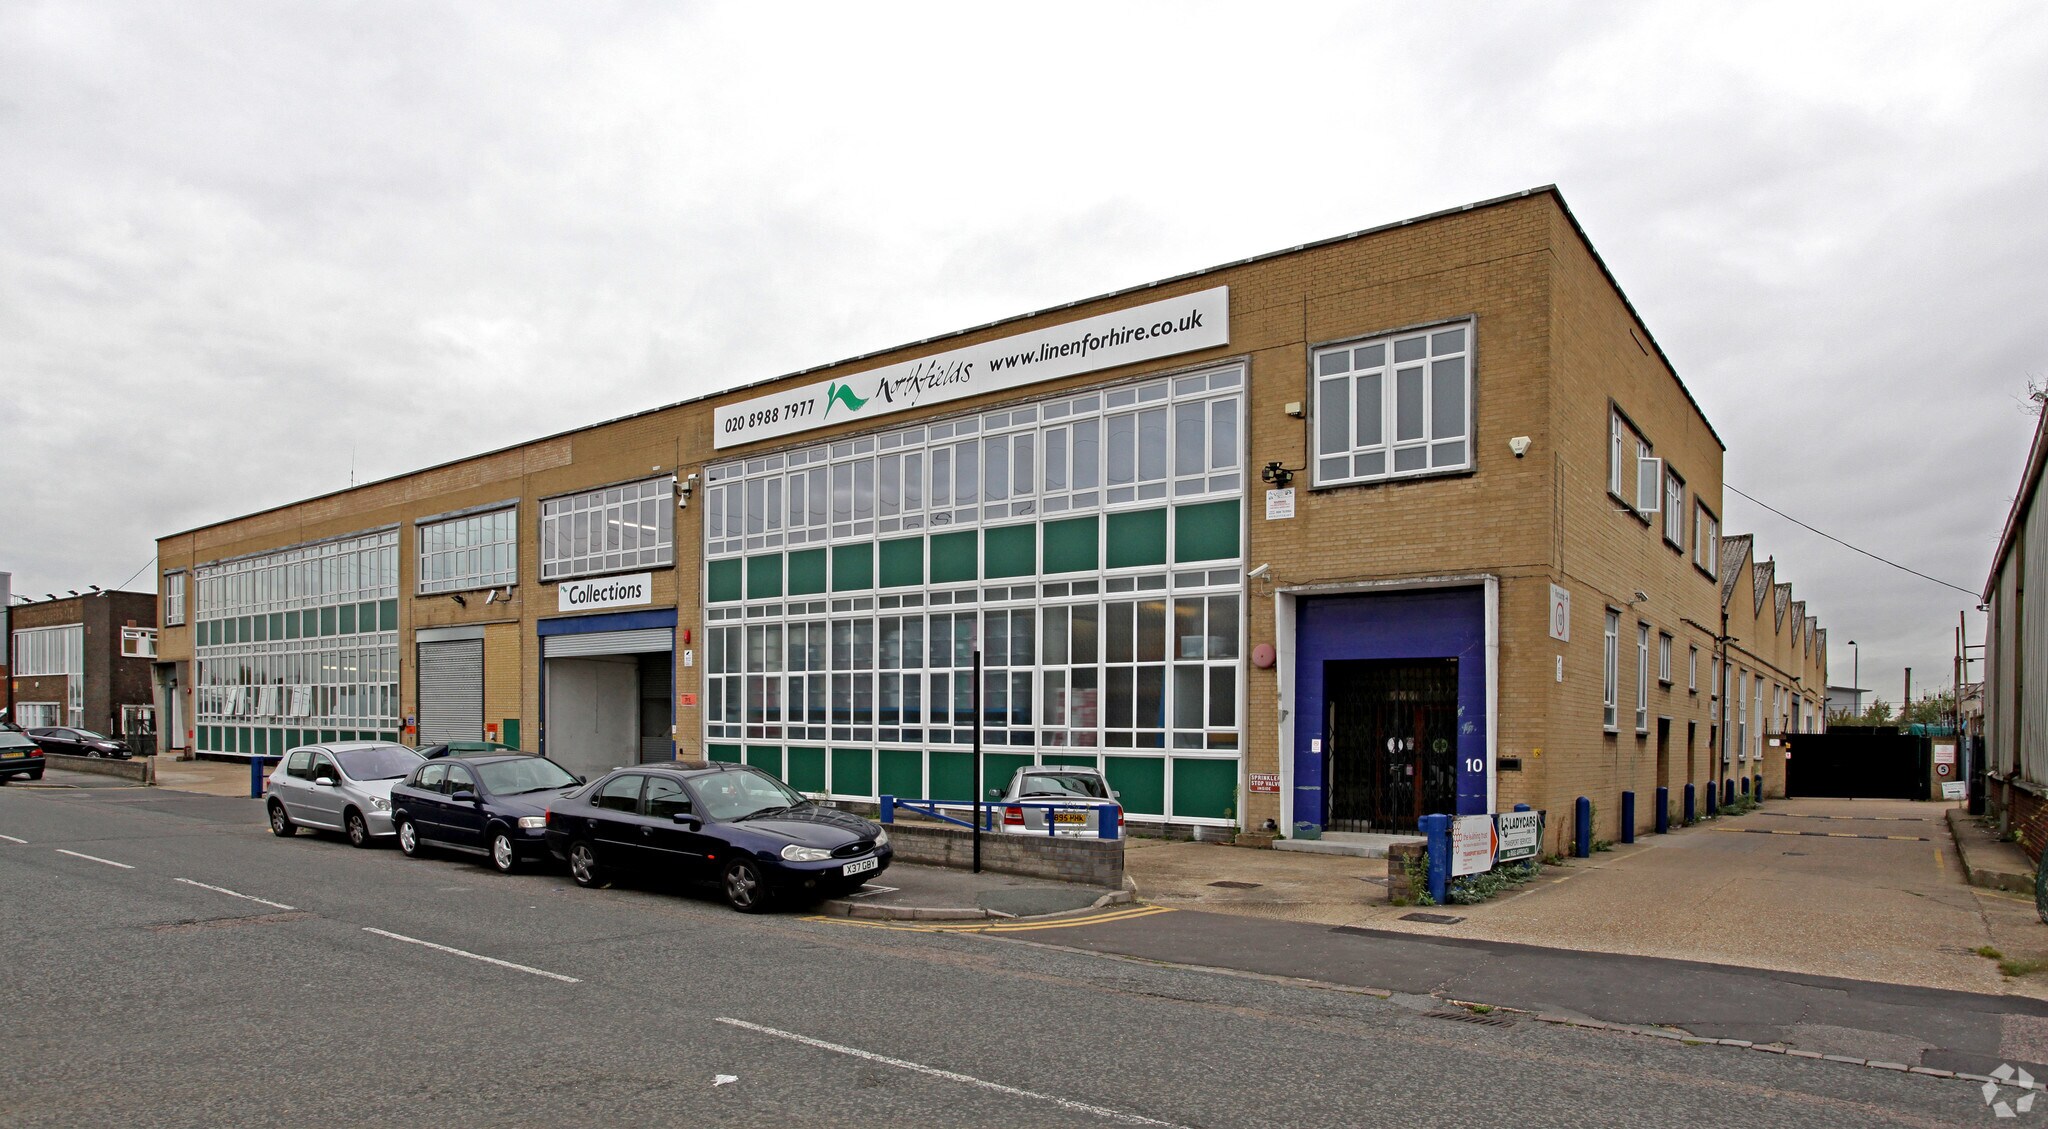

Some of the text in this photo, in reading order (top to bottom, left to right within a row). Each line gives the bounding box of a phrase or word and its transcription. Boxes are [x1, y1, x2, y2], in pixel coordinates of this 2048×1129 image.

[725, 415, 745, 434] 020
[748, 407, 779, 428] 8988
[784, 399, 815, 421] 7977
[989, 309, 1203, 372] www.linenforhire.co.uk
[569, 582, 642, 604] Collections
[1465, 758, 1483, 772] 10
[1053, 813, 1068, 822] 895
[1509, 816, 1535, 829] LADYCARS
[846, 859, 876, 874] X37 GBY
